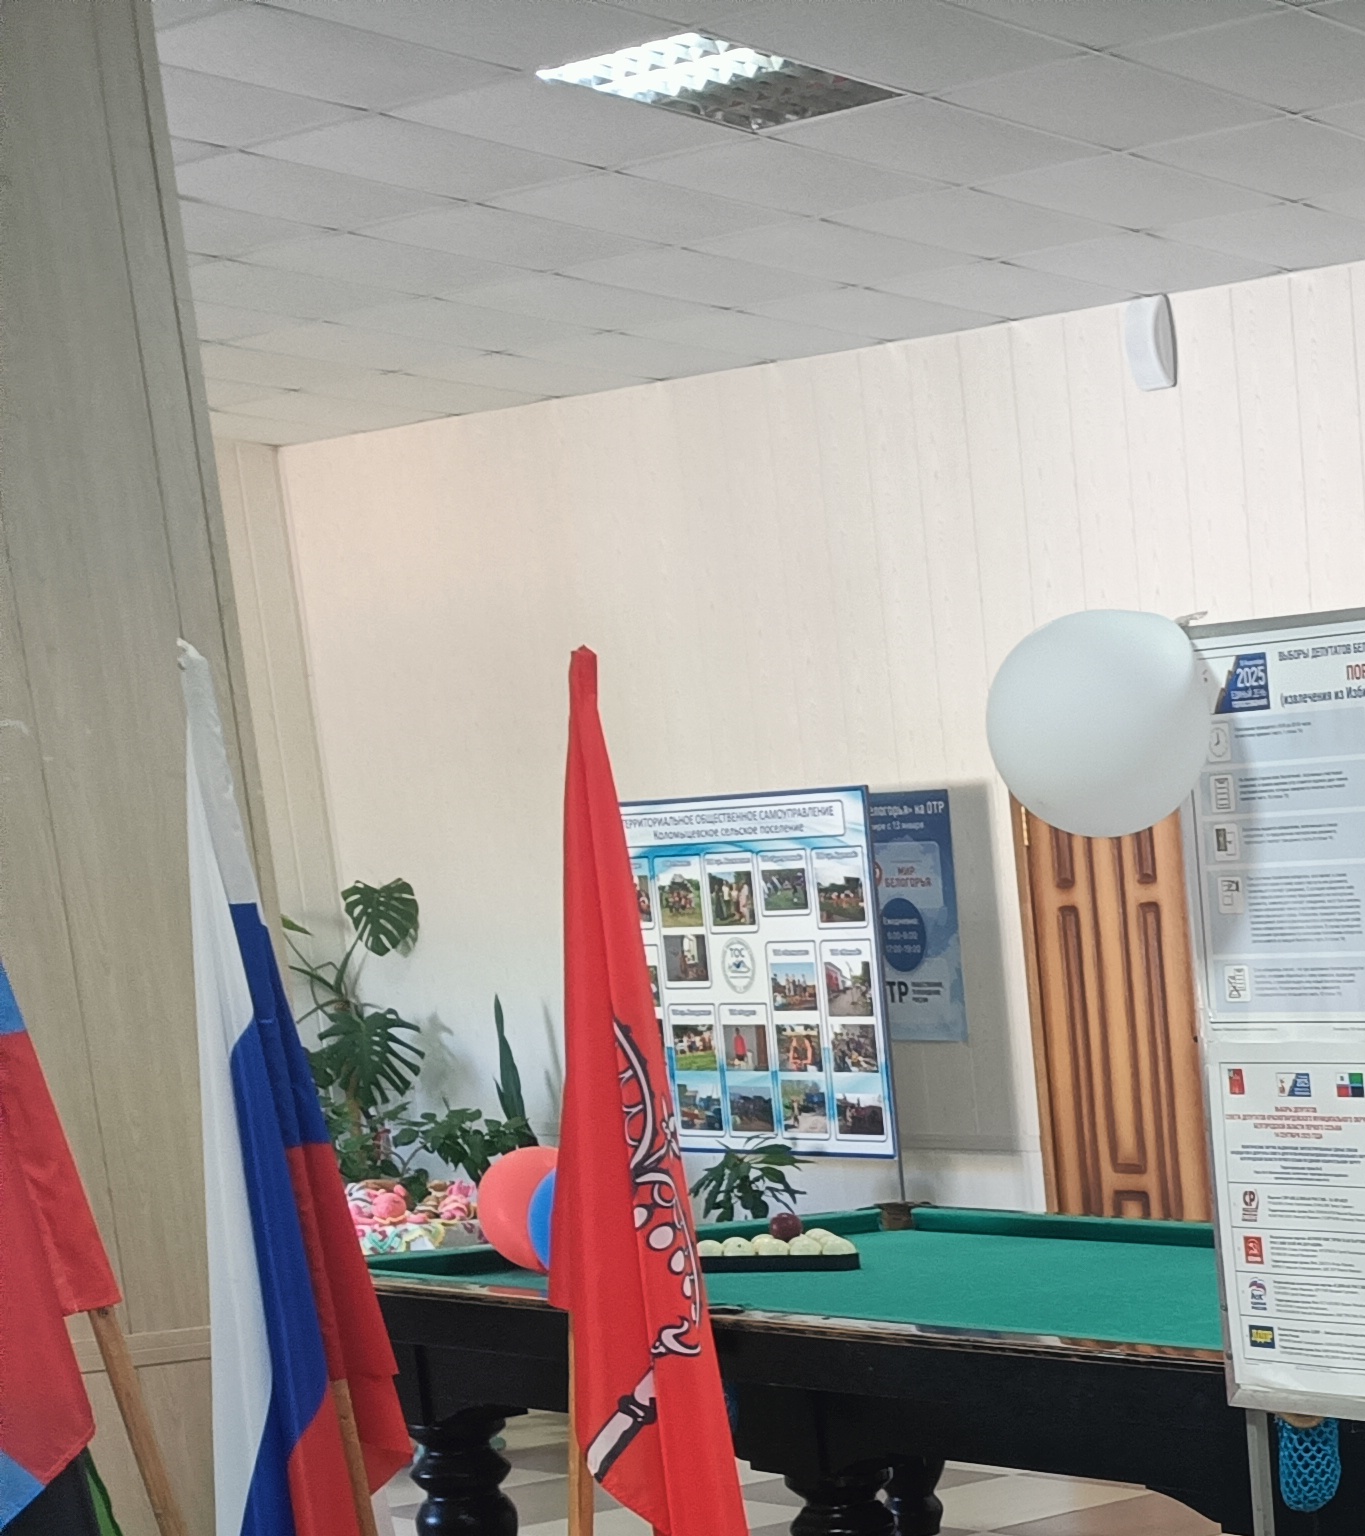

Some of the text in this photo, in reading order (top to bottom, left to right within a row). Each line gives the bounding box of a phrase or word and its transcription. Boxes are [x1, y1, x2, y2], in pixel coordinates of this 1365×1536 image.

[1278, 648, 1309, 662] ВЫБОРЫ
[1310, 643, 1352, 659] ДЕПУТАТОВ
[1236, 666, 1266, 687] 2025
[1280, 691, 1332, 708] (извлечения
[1333, 689, 1344, 700] из
[926, 801, 945, 815] ОТР
[730, 947, 745, 959] ТОС
